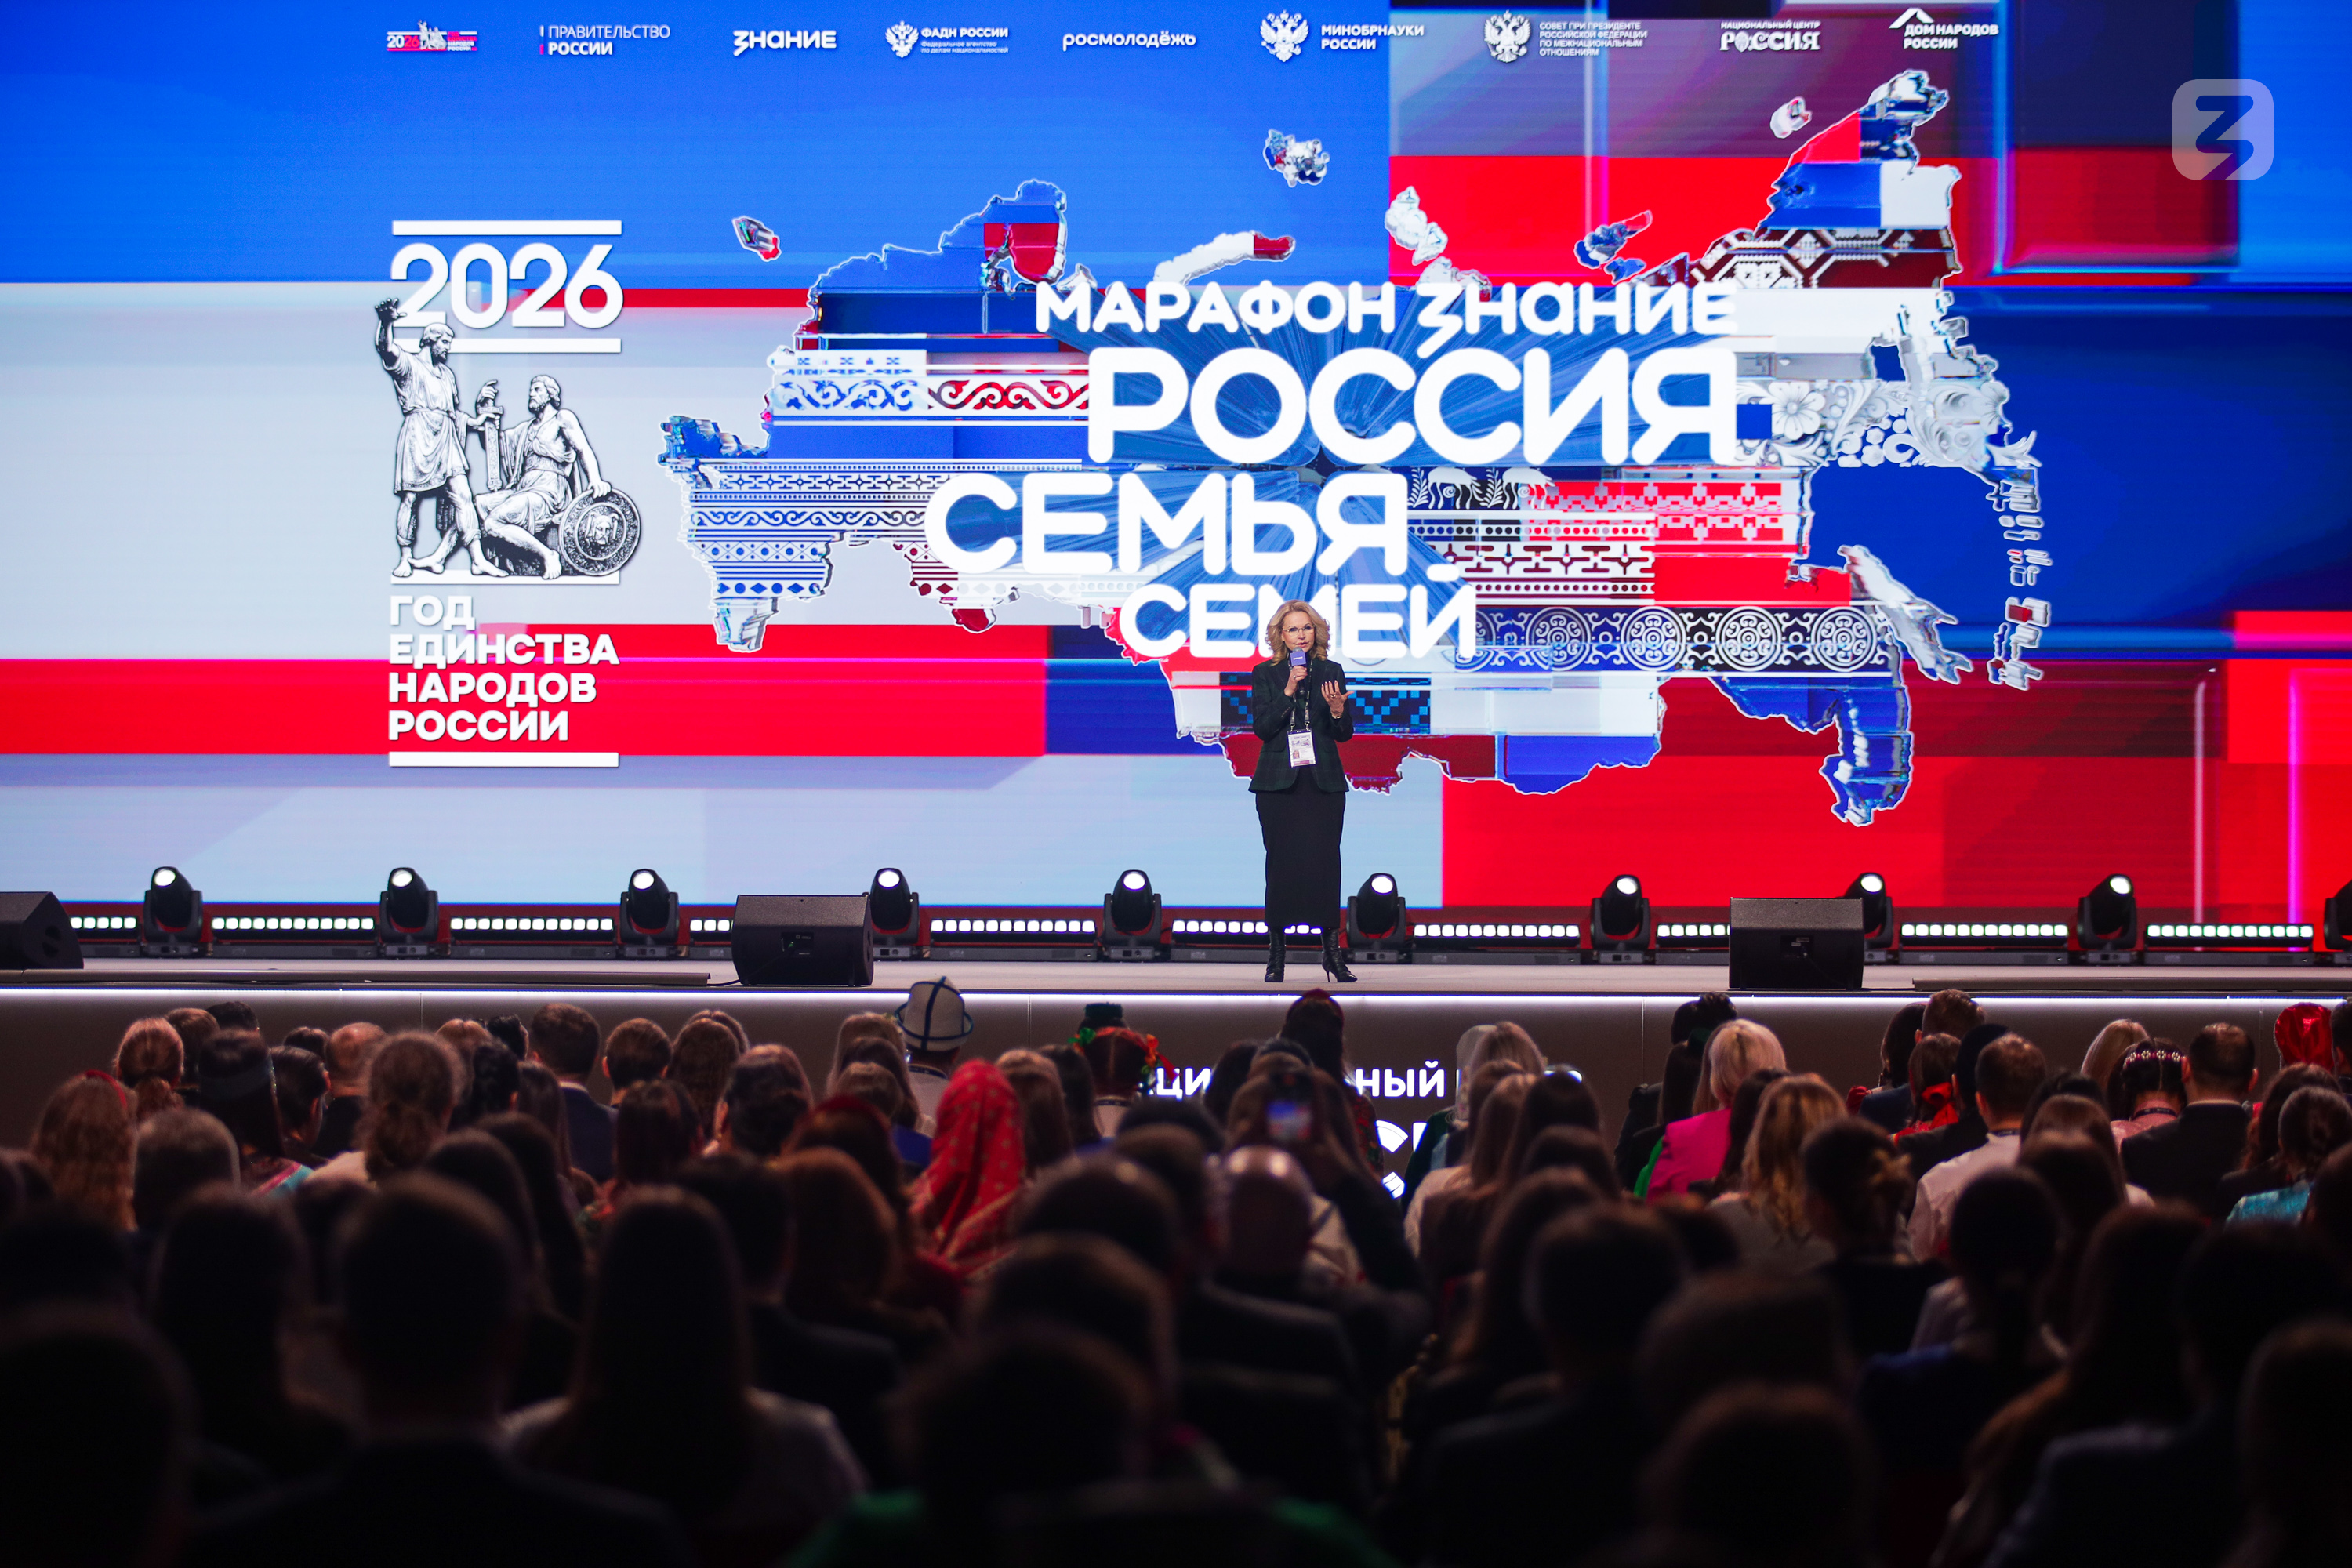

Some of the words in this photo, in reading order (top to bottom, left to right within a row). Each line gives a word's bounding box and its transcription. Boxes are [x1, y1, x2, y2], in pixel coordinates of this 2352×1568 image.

[1321, 24, 1425, 37] МИНОБРНАУКИ
[1588, 22, 1641, 31] ПРЕЗИДЕНТЕ
[1721, 20, 1791, 30] НАЦИОНАЛЬНЫЙ
[1792, 21, 1820, 30] ЦЕНТР
[1904, 24, 1935, 37] ДОМ
[1936, 24, 1999, 37] НАРОДОВ
[548, 25, 670, 39] ПРАВИТЕЛЬСТВО
[920, 27, 957, 39] ФАДН
[959, 27, 1009, 38] РОССИИ
[1539, 30, 1596, 38] РОССИЙСКОЙ
[1597, 31, 1647, 40] ФЕДЕРАЦИИ
[387, 35, 419, 48] 2026
[1062, 30, 1196, 51] росмолодёжь
[1321, 38, 1377, 50] РОССИИ
[1553, 39, 1642, 48] МЕЖНАЦИОНАЛЬНЫМ
[1720, 31, 1821, 53] РОССИЯ
[1904, 38, 1958, 49] РОССИИ
[548, 42, 613, 55] РОССИИ
[1539, 47, 1599, 56] ОТНОШЕНИЯМ
[390, 242, 624, 329] 2026
[1035, 281, 1396, 335] МАРАФОН
[1087, 346, 1737, 466] РОССИЯ
[924, 472, 1409, 576] СЕМЬЯ
[390, 595, 476, 630] ГОД
[390, 633, 621, 670] ЕДИНСТВА
[389, 672, 598, 708] НАРОДОВ
[388, 710, 569, 742] РОССИИ
